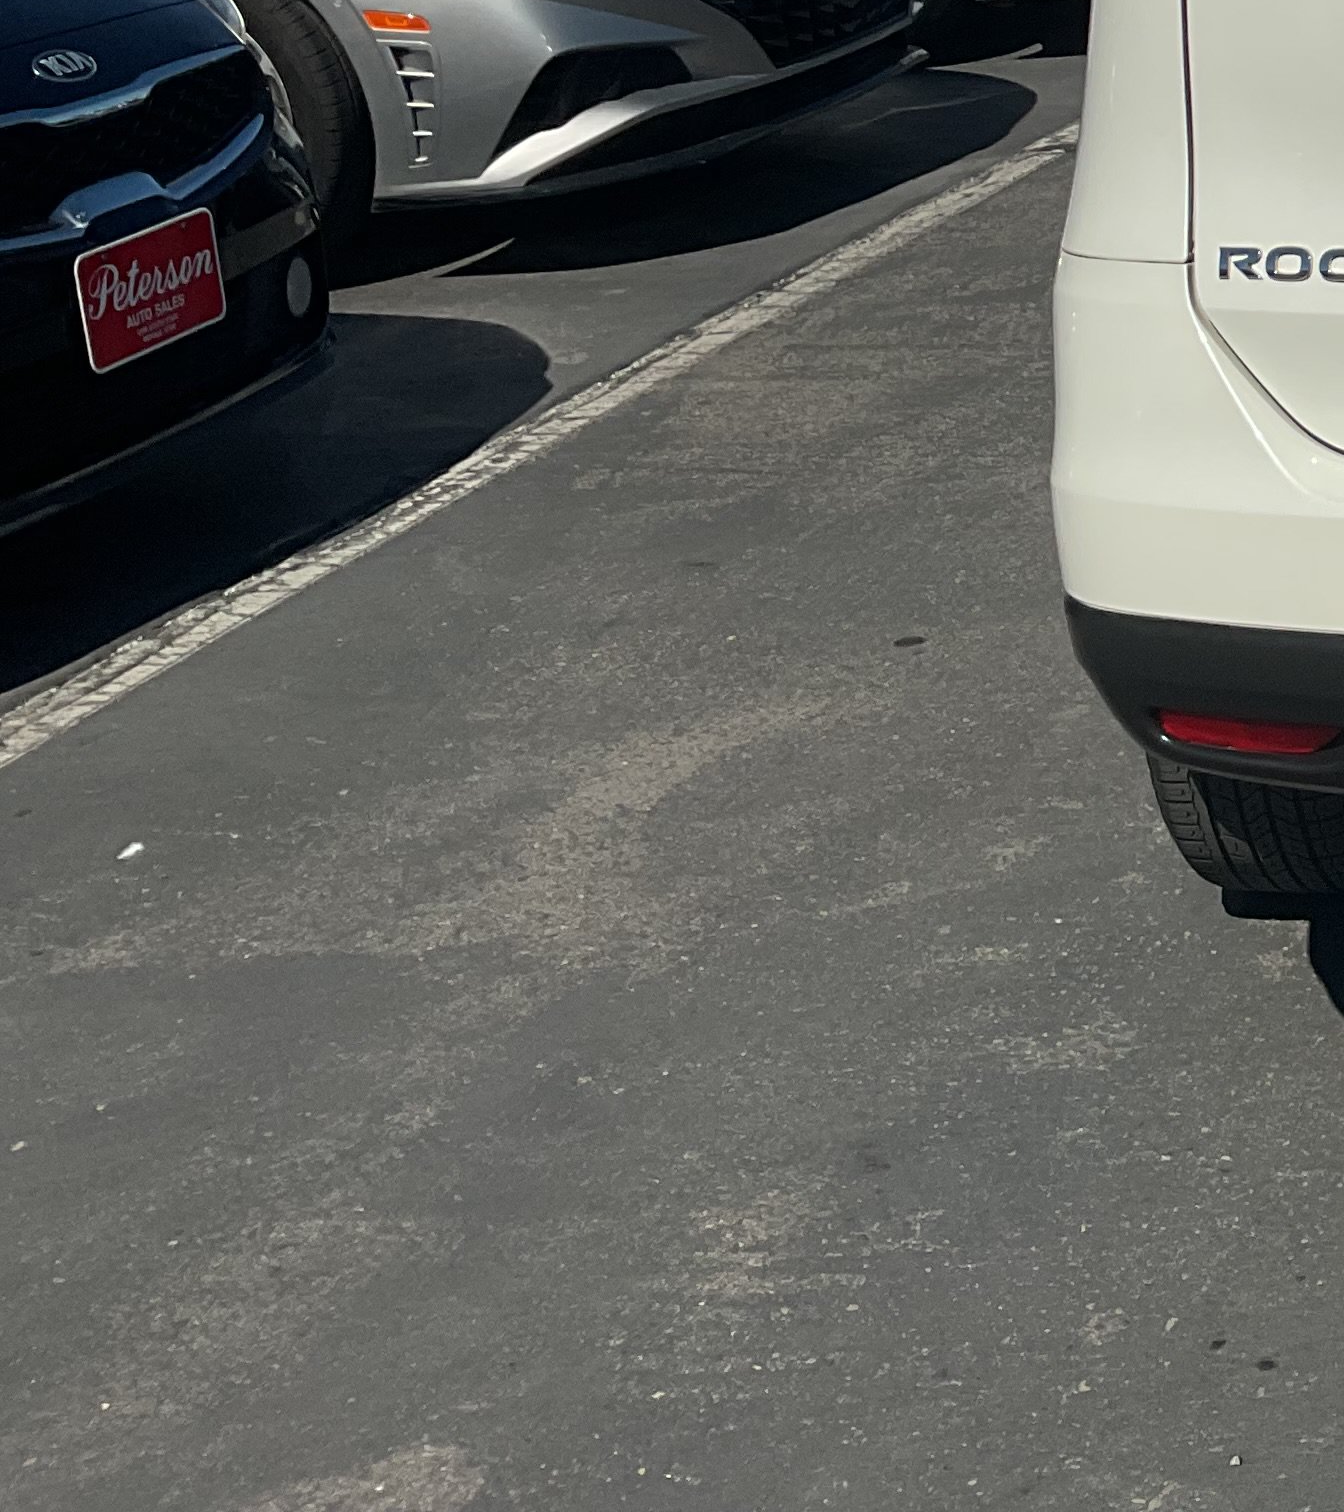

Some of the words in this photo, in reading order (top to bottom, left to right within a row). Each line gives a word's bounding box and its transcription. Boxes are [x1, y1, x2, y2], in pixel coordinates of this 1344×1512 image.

[39, 51, 93, 77] KIA
[88, 248, 214, 320] Peterson
[126, 307, 153, 329] AUTO
[154, 293, 186, 317] SALES
